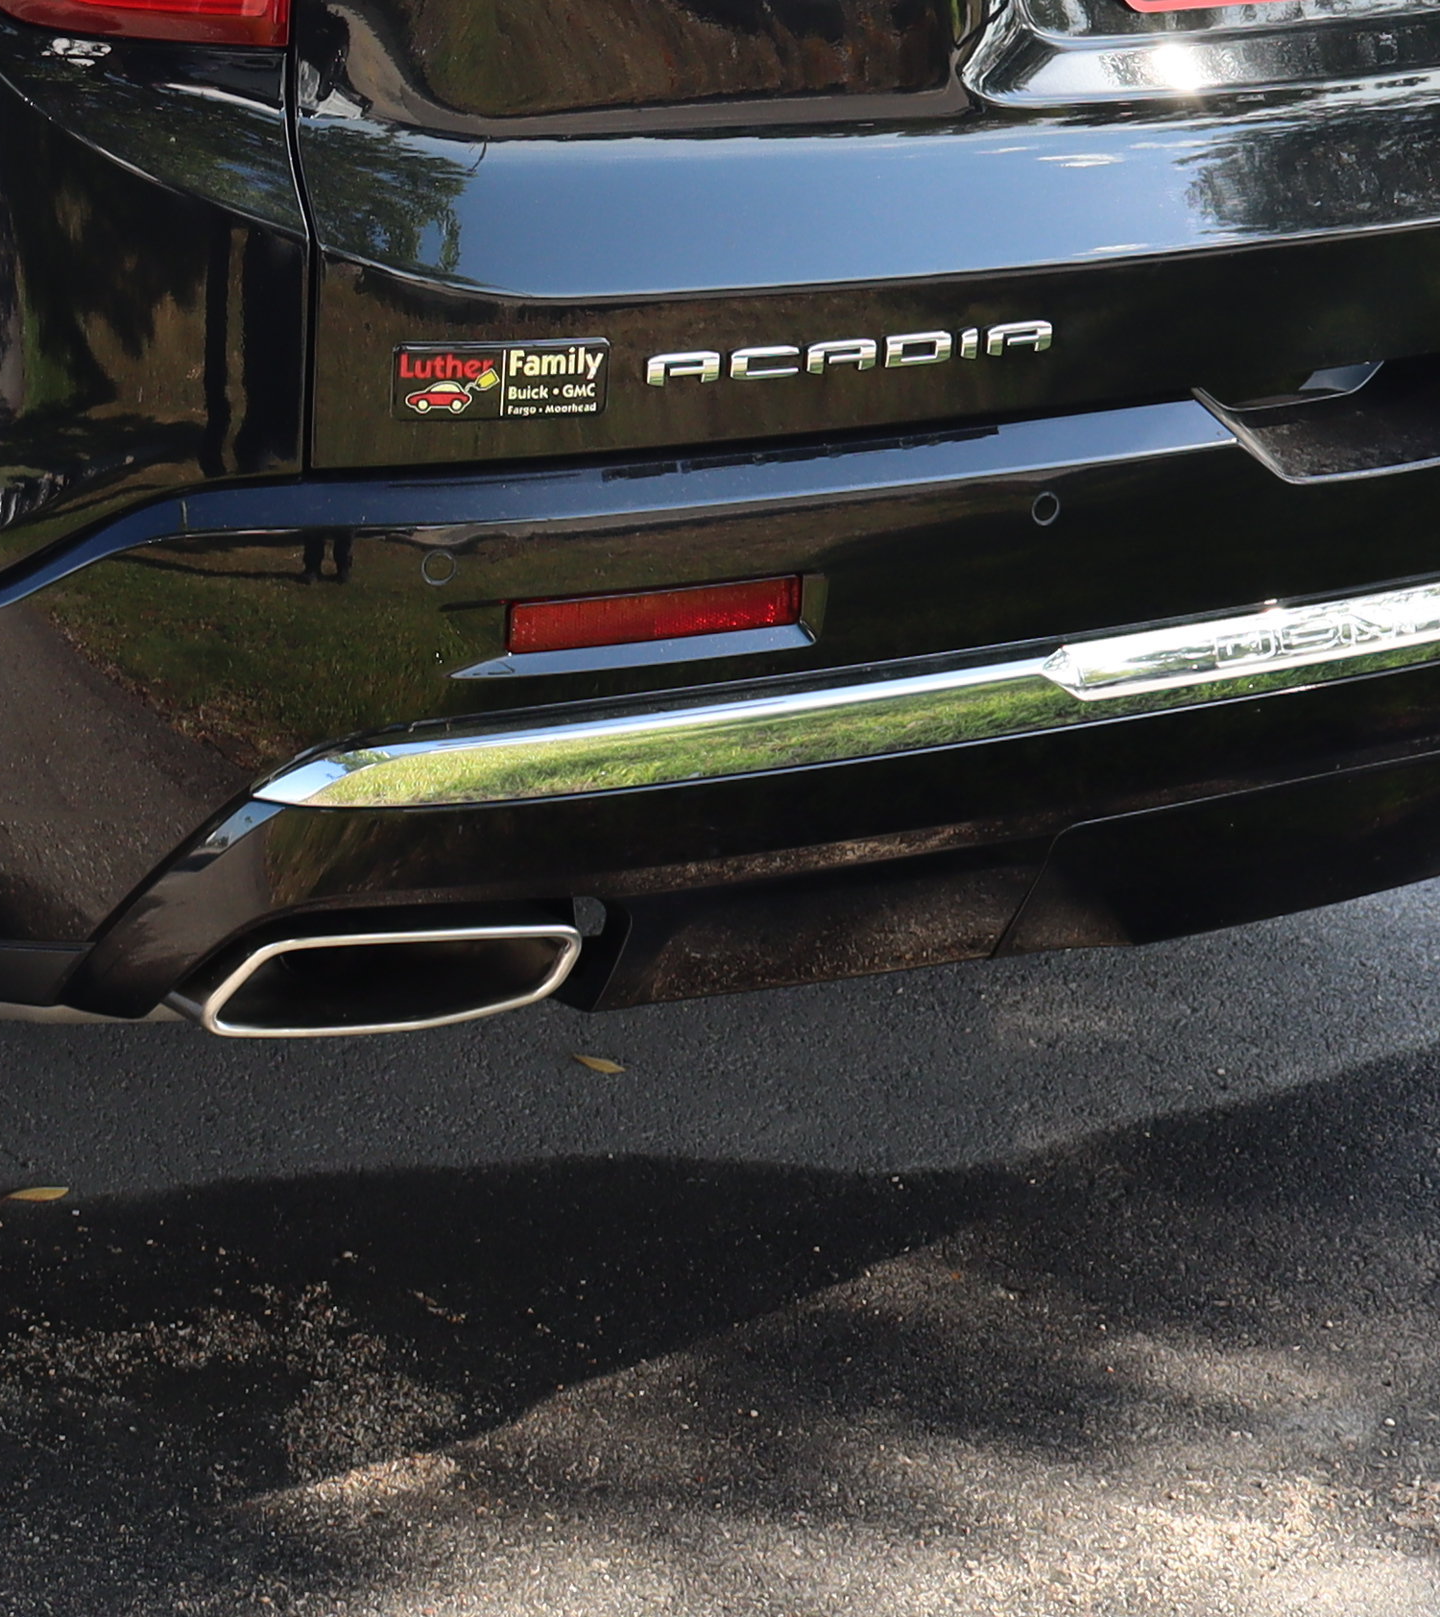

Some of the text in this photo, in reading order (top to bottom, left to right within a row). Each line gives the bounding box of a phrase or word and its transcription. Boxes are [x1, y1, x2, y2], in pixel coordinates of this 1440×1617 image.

[399, 347, 604, 380] Luther Family
[646, 320, 1052, 386] ACADIA
[508, 383, 596, 400] Buick GMC
[507, 402, 596, 416] Fargo Moorhead
